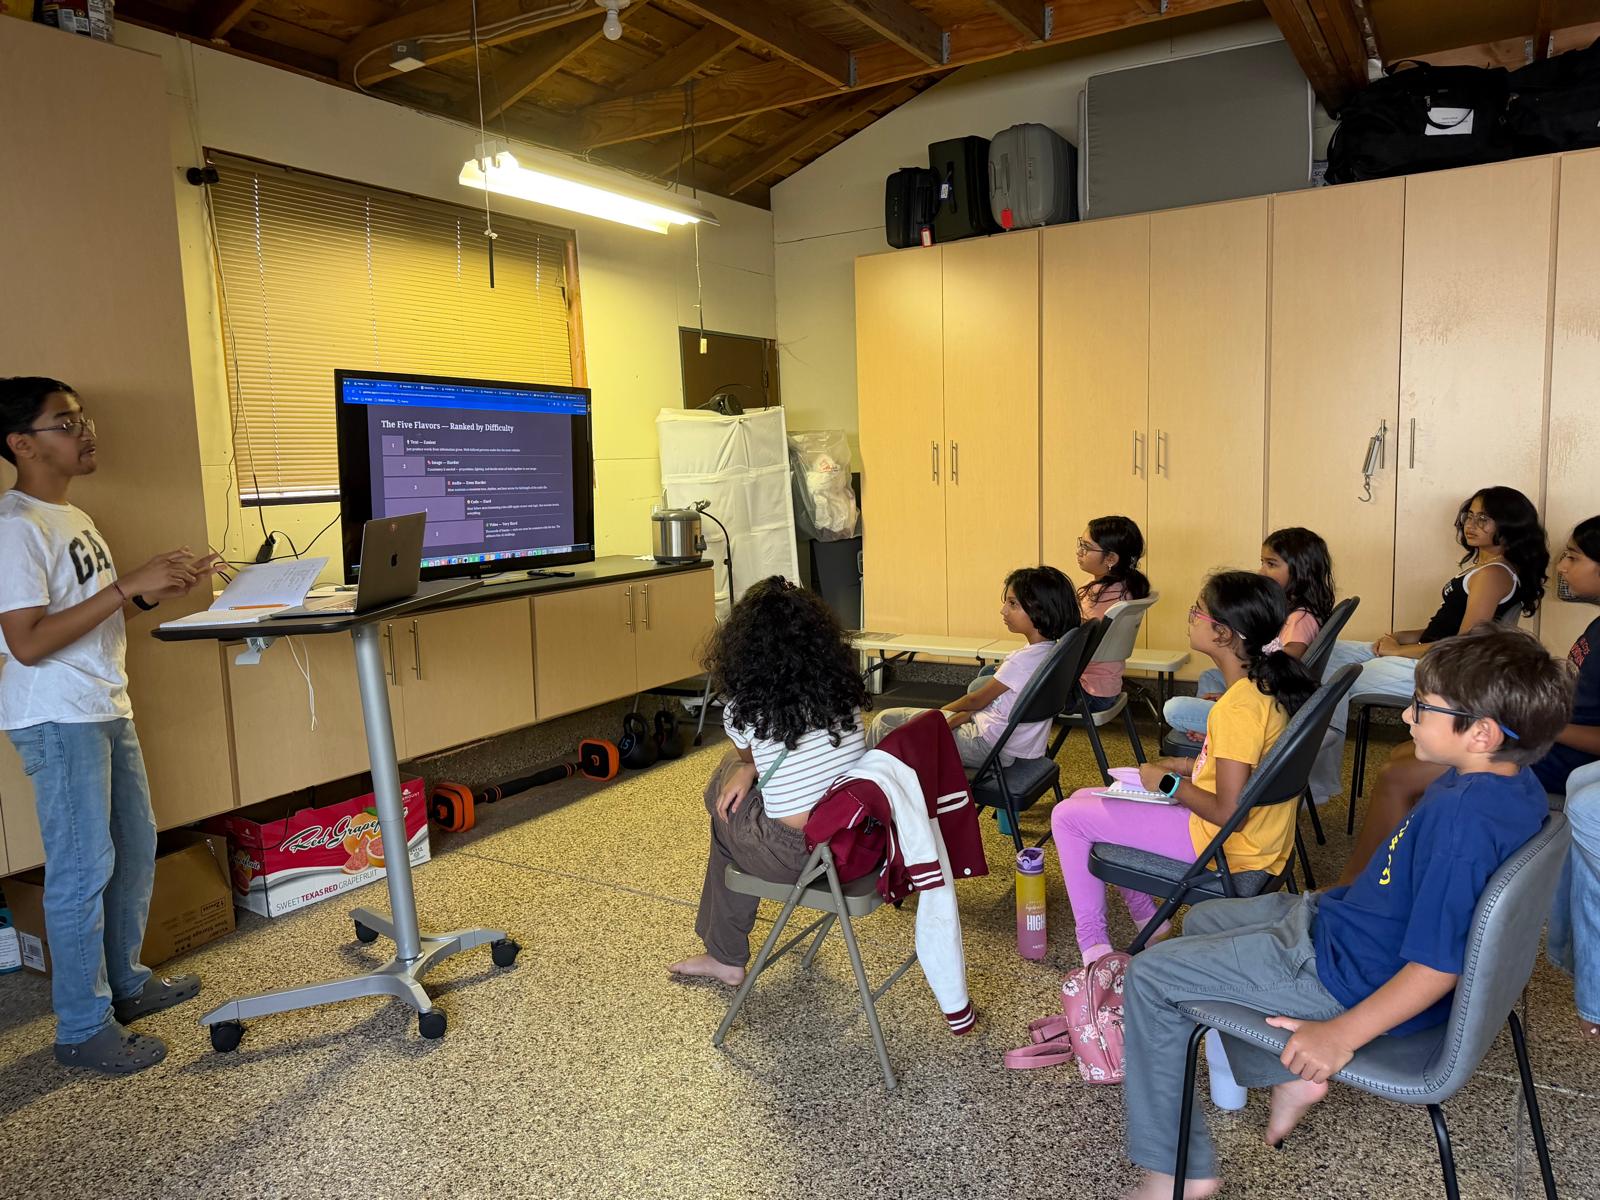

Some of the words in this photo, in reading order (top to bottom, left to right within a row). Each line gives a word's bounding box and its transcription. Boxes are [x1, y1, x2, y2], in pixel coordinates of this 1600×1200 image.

[381, 420, 396, 429] The
[397, 420, 413, 429] Five
[414, 421, 441, 430] Flavors
[450, 422, 475, 431] Ranked
[475, 422, 484, 433] by
[485, 423, 514, 433] Difficulty
[280, 825, 332, 853] Red
[276, 897, 300, 912] SWEET
[301, 889, 324, 902] TEXAS
[324, 884, 338, 895] RED
[338, 869, 378, 889] GRAPEFRUIT
